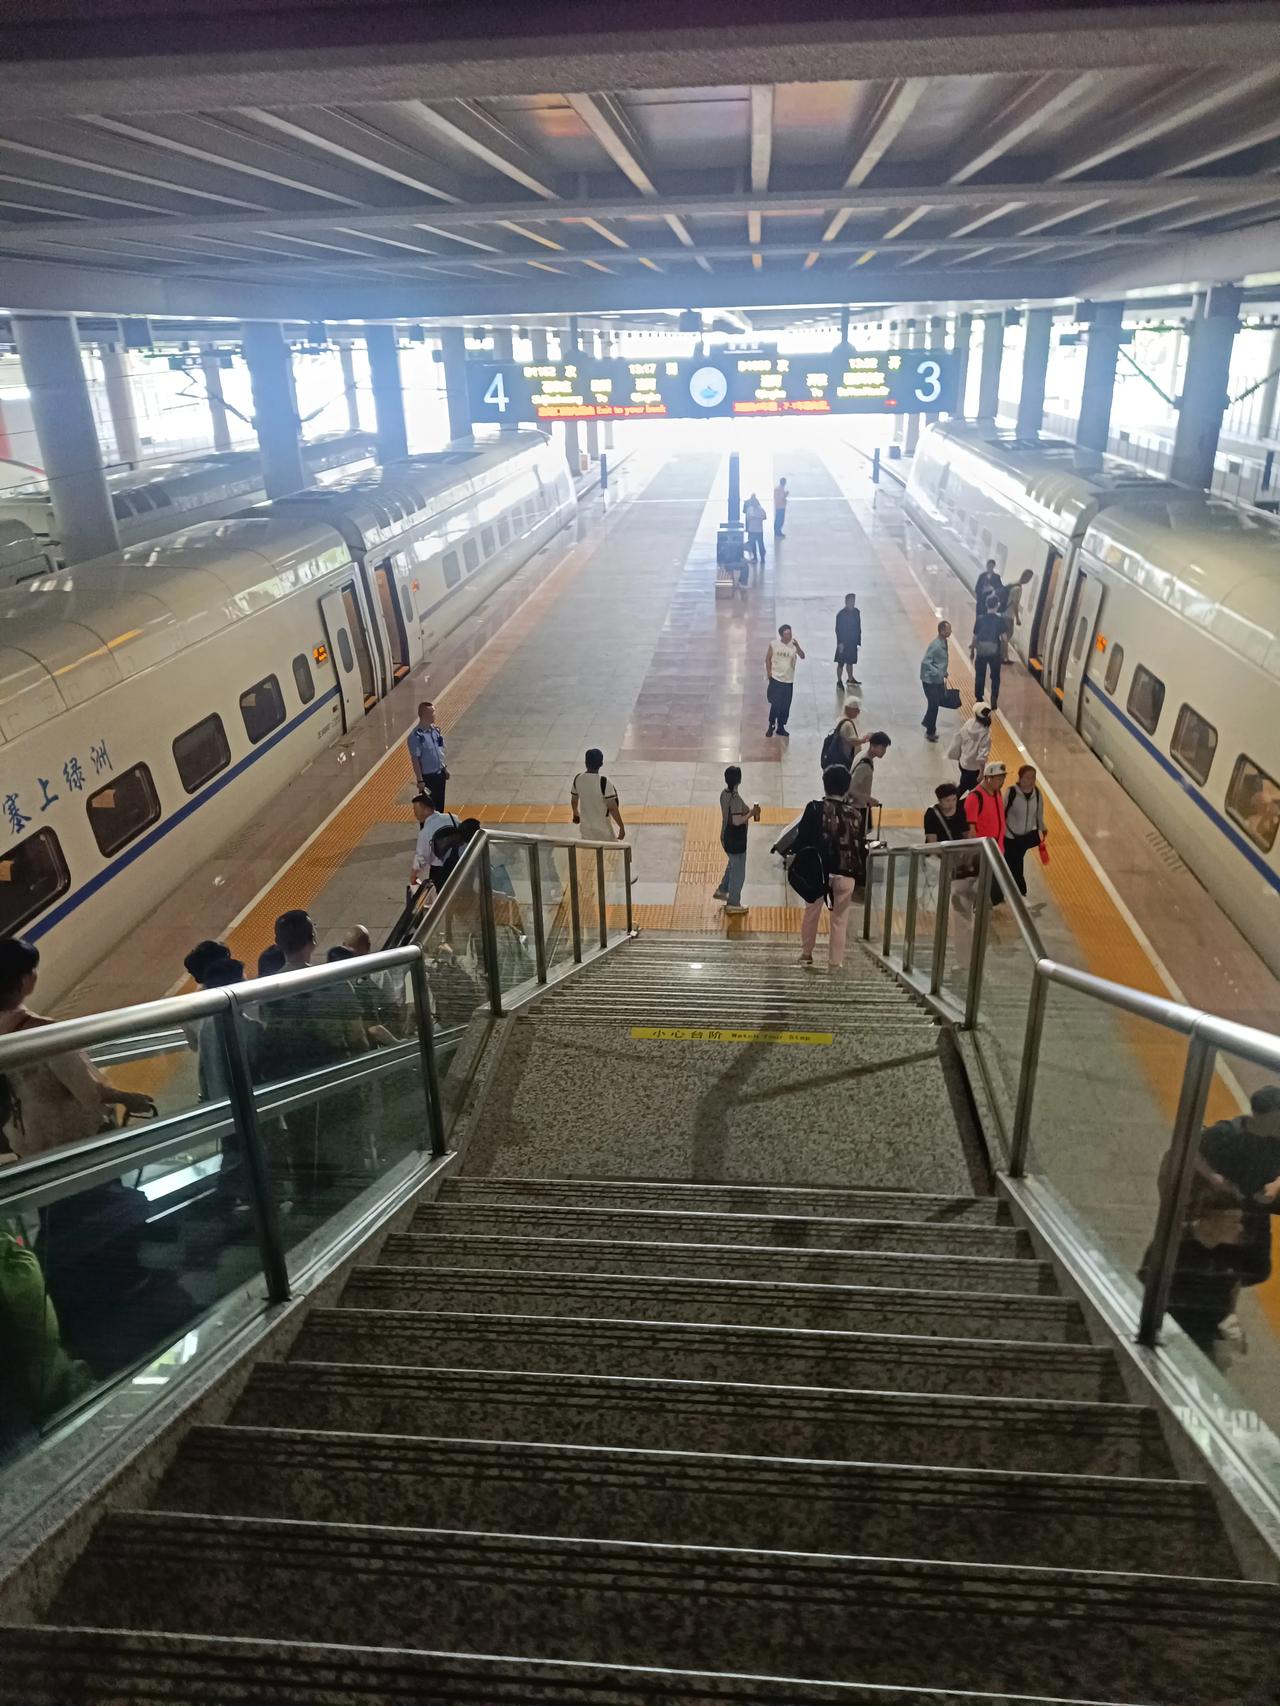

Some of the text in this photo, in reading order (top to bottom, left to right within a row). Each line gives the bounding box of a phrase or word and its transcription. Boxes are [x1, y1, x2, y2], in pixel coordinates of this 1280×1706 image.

[483, 372, 510, 413] 4
[914, 360, 941, 403] 3
[652, 1030, 723, 1040] 小心台阶
